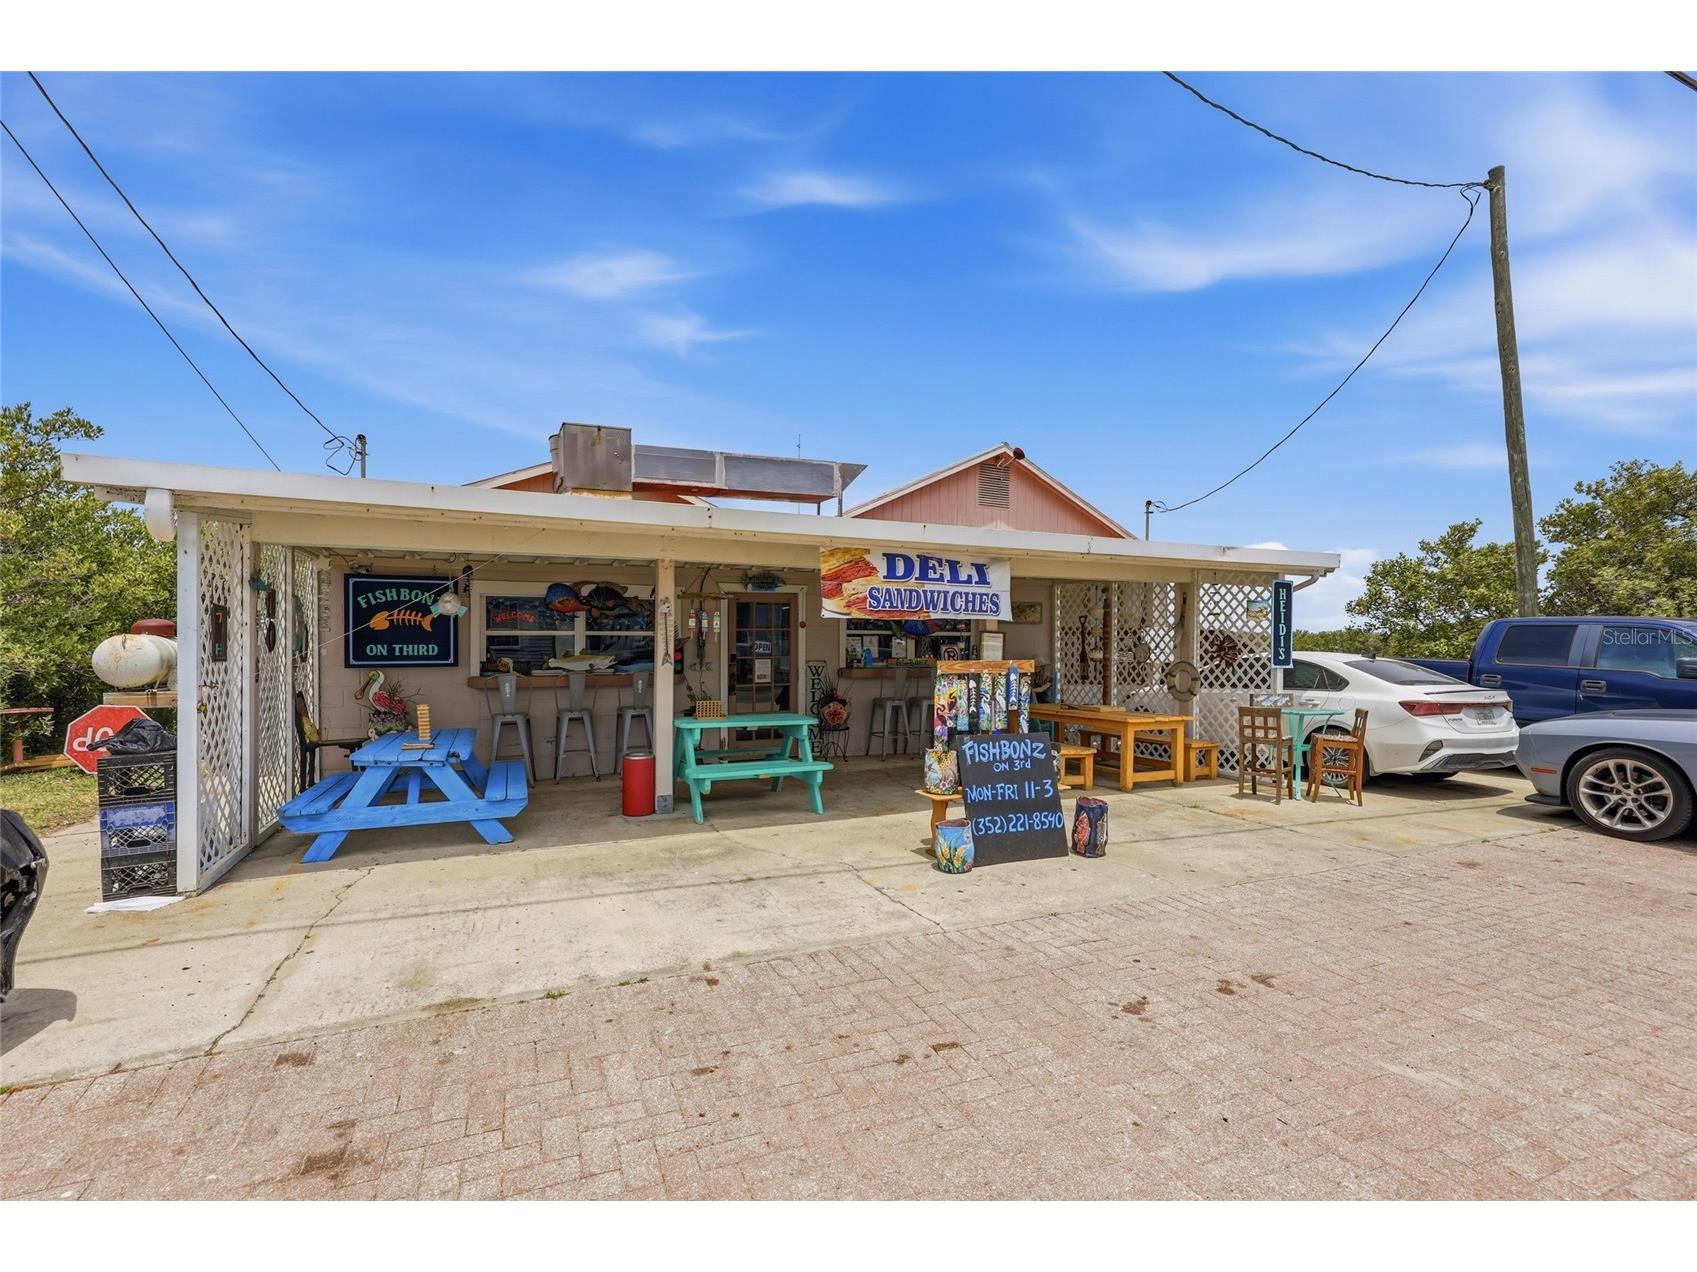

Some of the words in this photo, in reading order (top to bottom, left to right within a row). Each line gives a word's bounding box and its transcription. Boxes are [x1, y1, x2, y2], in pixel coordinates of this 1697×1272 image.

[881, 552, 992, 586] DELI
[357, 588, 436, 608] FISHBON
[867, 587, 1001, 615] SANDWICHES
[366, 644, 388, 656] ON
[392, 644, 439, 656] THIRD
[754, 642, 771, 652] OPEN
[962, 739, 1046, 765] FISHBONZ
[993, 762, 1010, 773] ON
[1013, 759, 1031, 771] 3rd
[965, 783, 1018, 803] MON-FRI
[1024, 779, 1054, 799] 11-3
